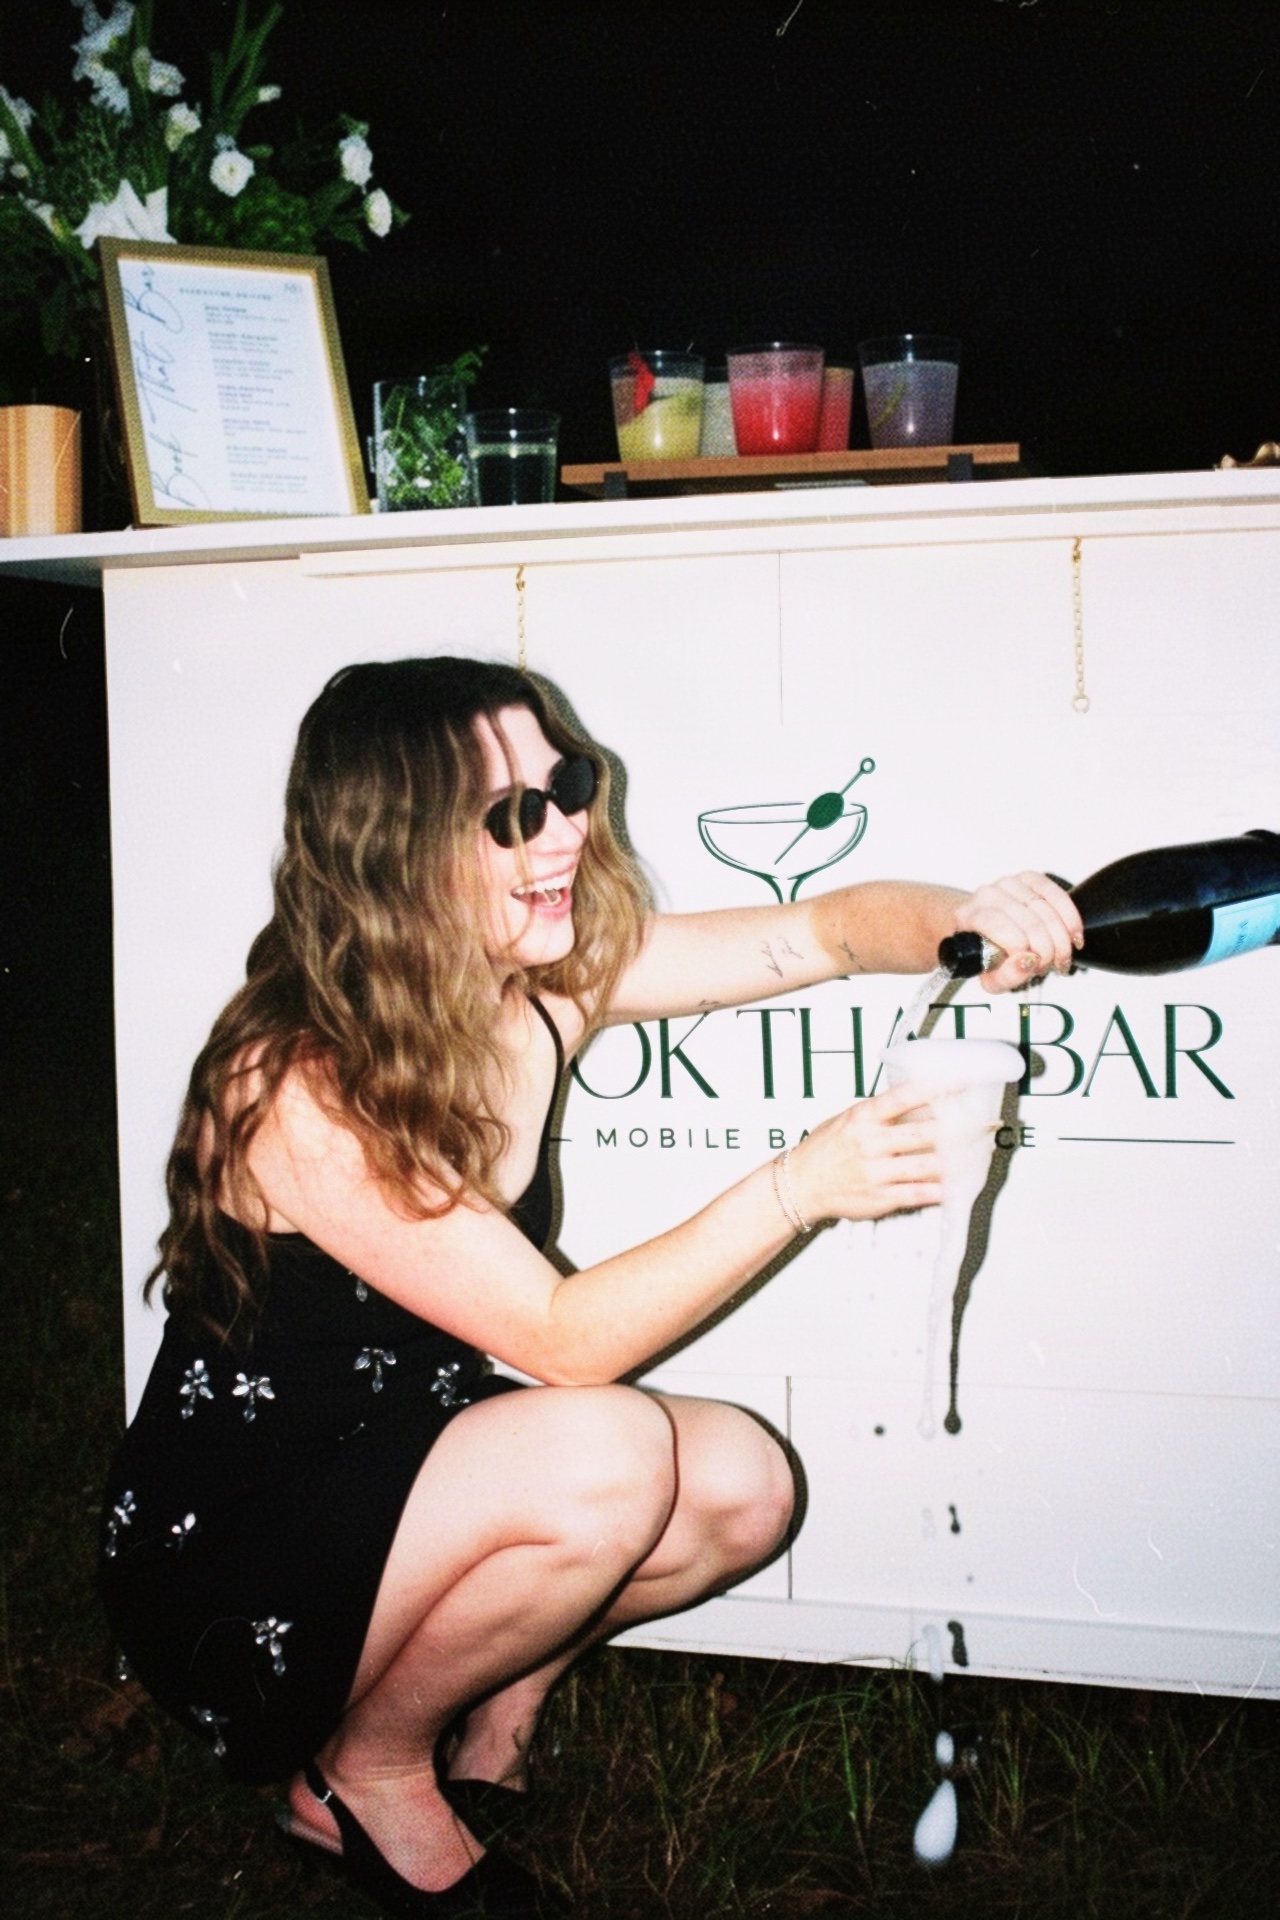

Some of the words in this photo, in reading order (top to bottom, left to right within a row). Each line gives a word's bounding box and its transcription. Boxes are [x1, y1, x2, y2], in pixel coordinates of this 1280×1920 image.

[569, 1010, 720, 1100] OK
[1018, 1003, 1236, 1100] BAR
[596, 1127, 741, 1149] MOBILE
